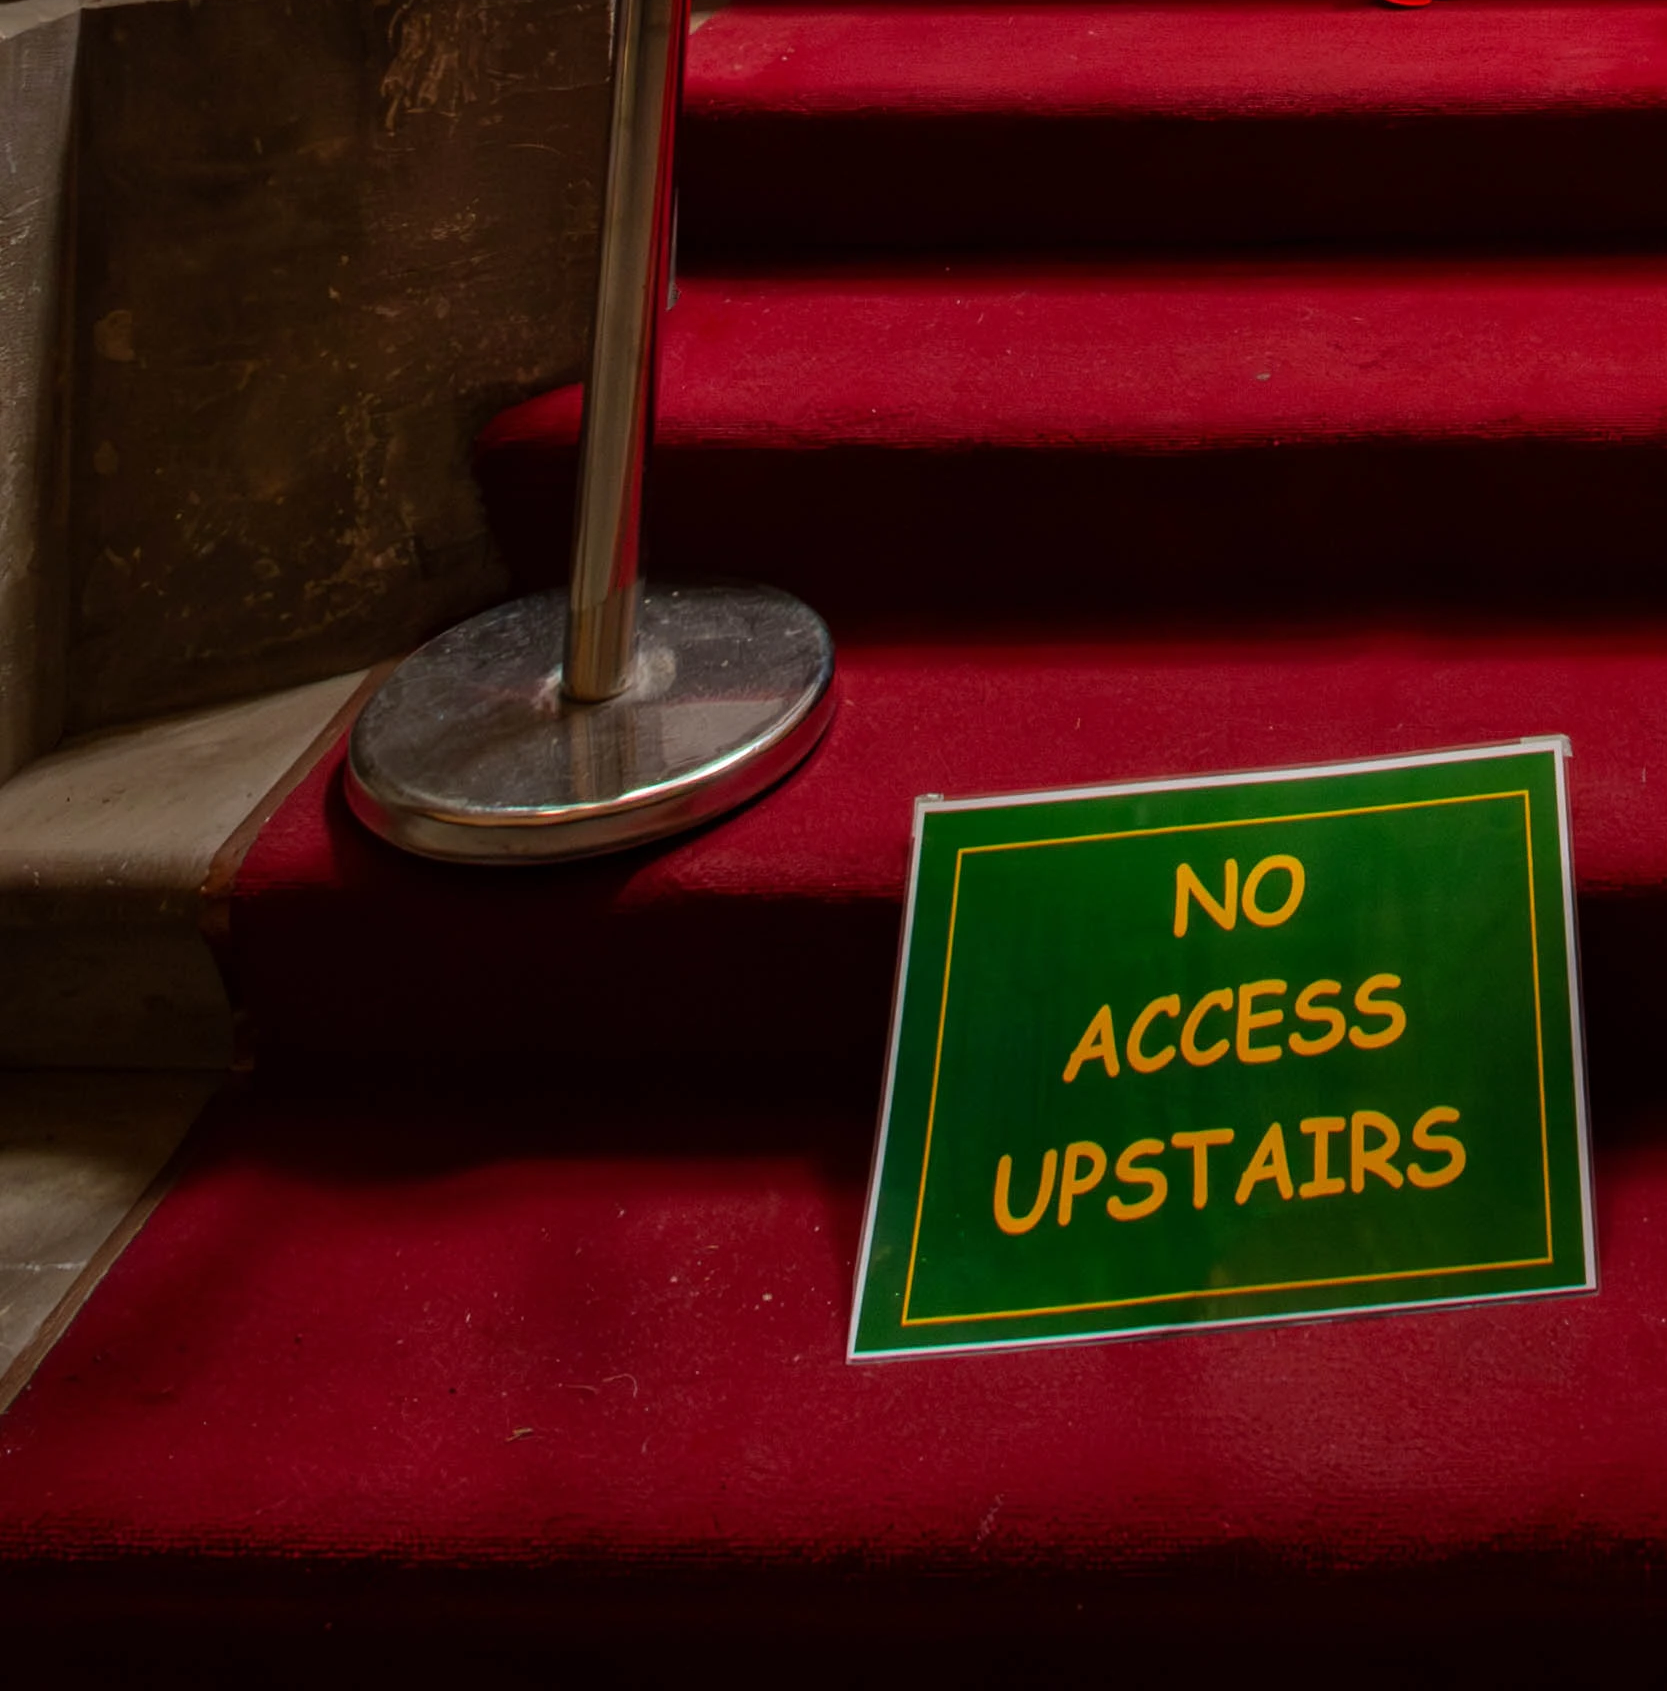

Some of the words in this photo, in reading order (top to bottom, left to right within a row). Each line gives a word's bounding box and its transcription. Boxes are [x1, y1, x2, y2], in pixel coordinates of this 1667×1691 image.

[1172, 853, 1307, 938] NO
[1062, 972, 1408, 1084] ACCESS
[992, 1104, 1468, 1238] UPSTAIRS
